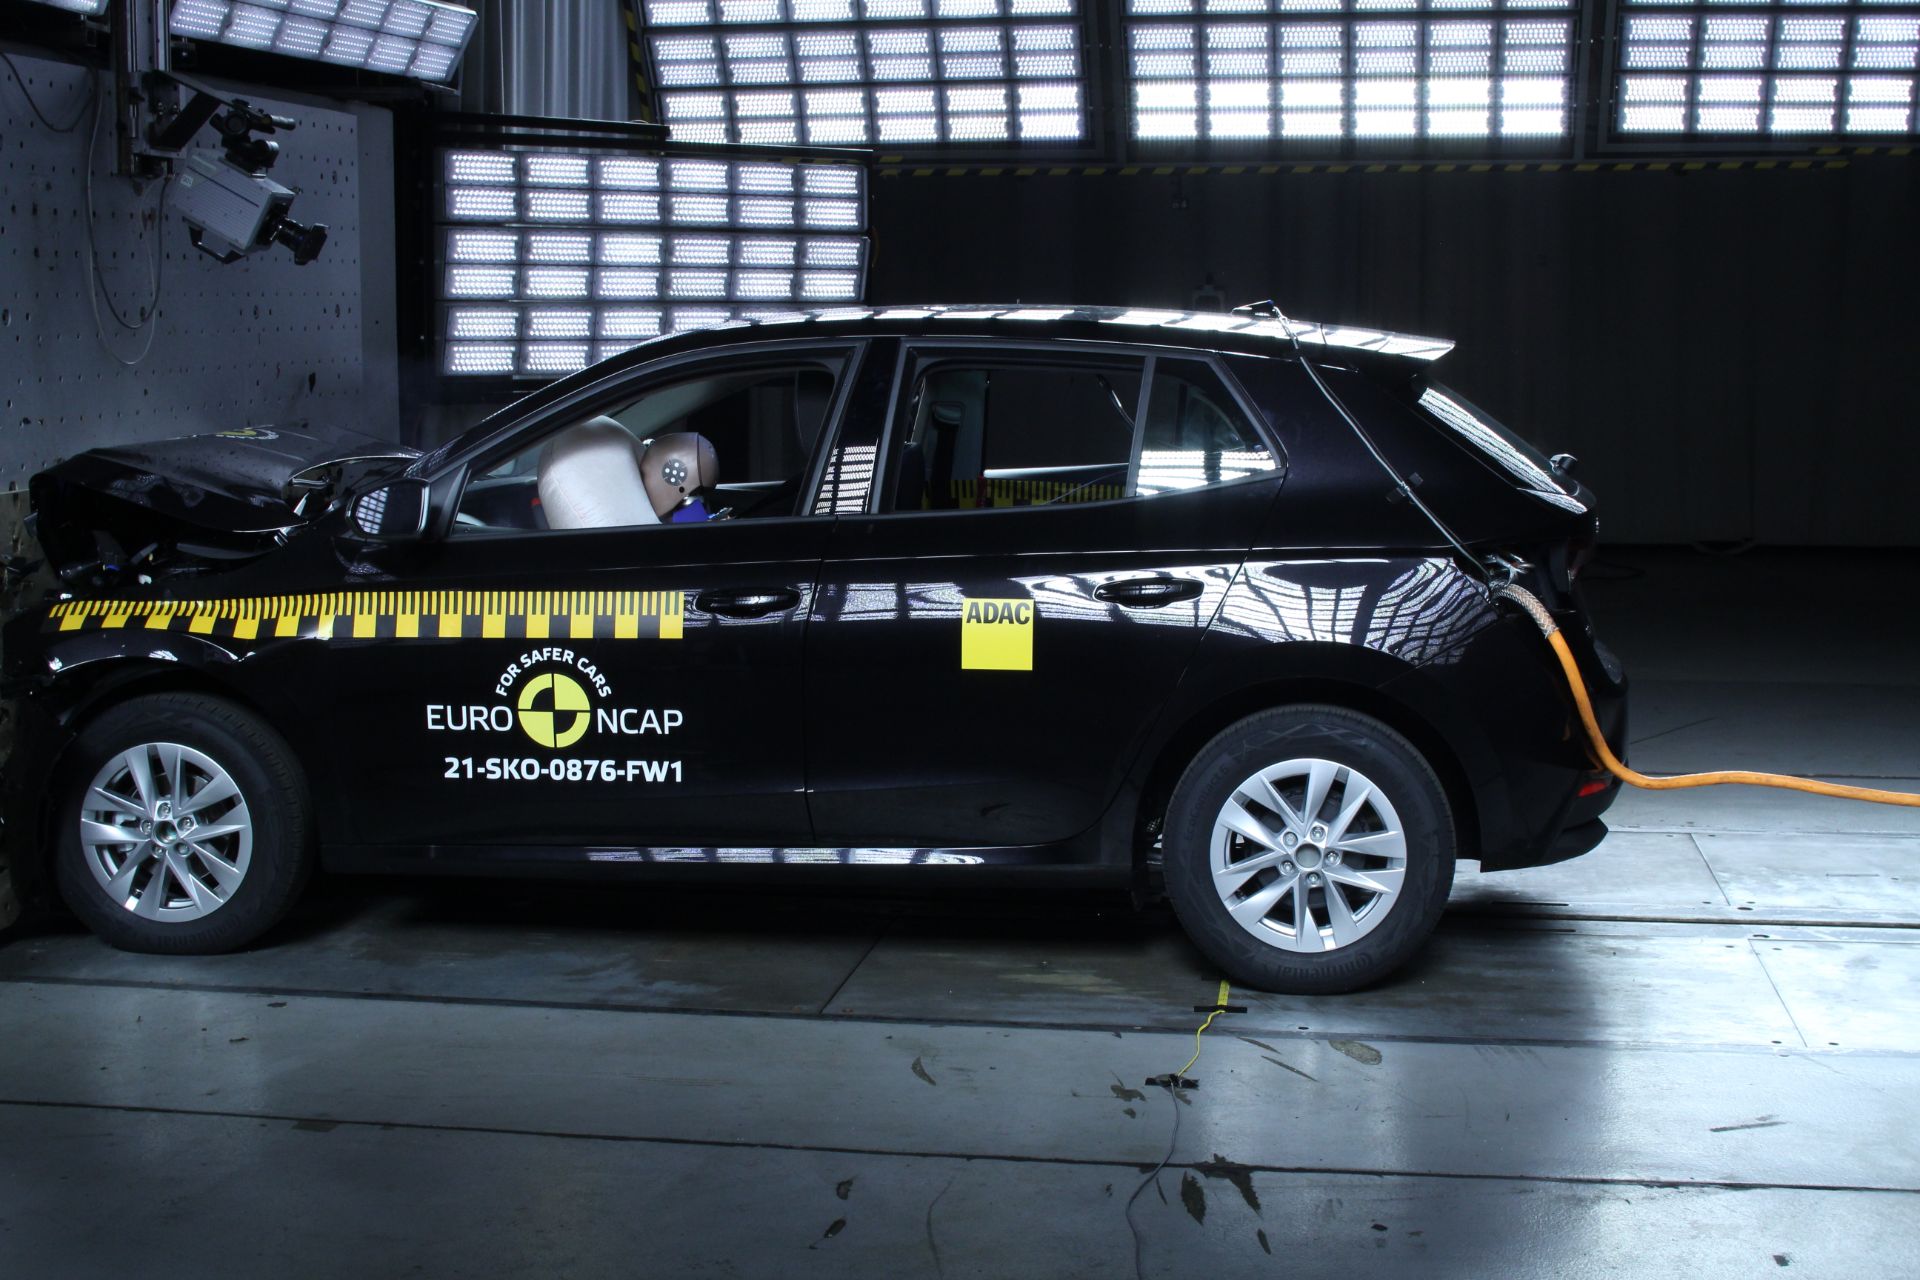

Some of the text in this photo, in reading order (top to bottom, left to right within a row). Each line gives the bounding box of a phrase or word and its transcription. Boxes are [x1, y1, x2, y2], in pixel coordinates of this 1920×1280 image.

[966, 602, 1030, 625] ADAC
[495, 647, 612, 698] FOR SAFER CARS
[426, 705, 684, 735] EURO NCAP
[444, 757, 683, 782] 21-SKO-0876-FW1
[1277, 952, 1374, 979] Continental
